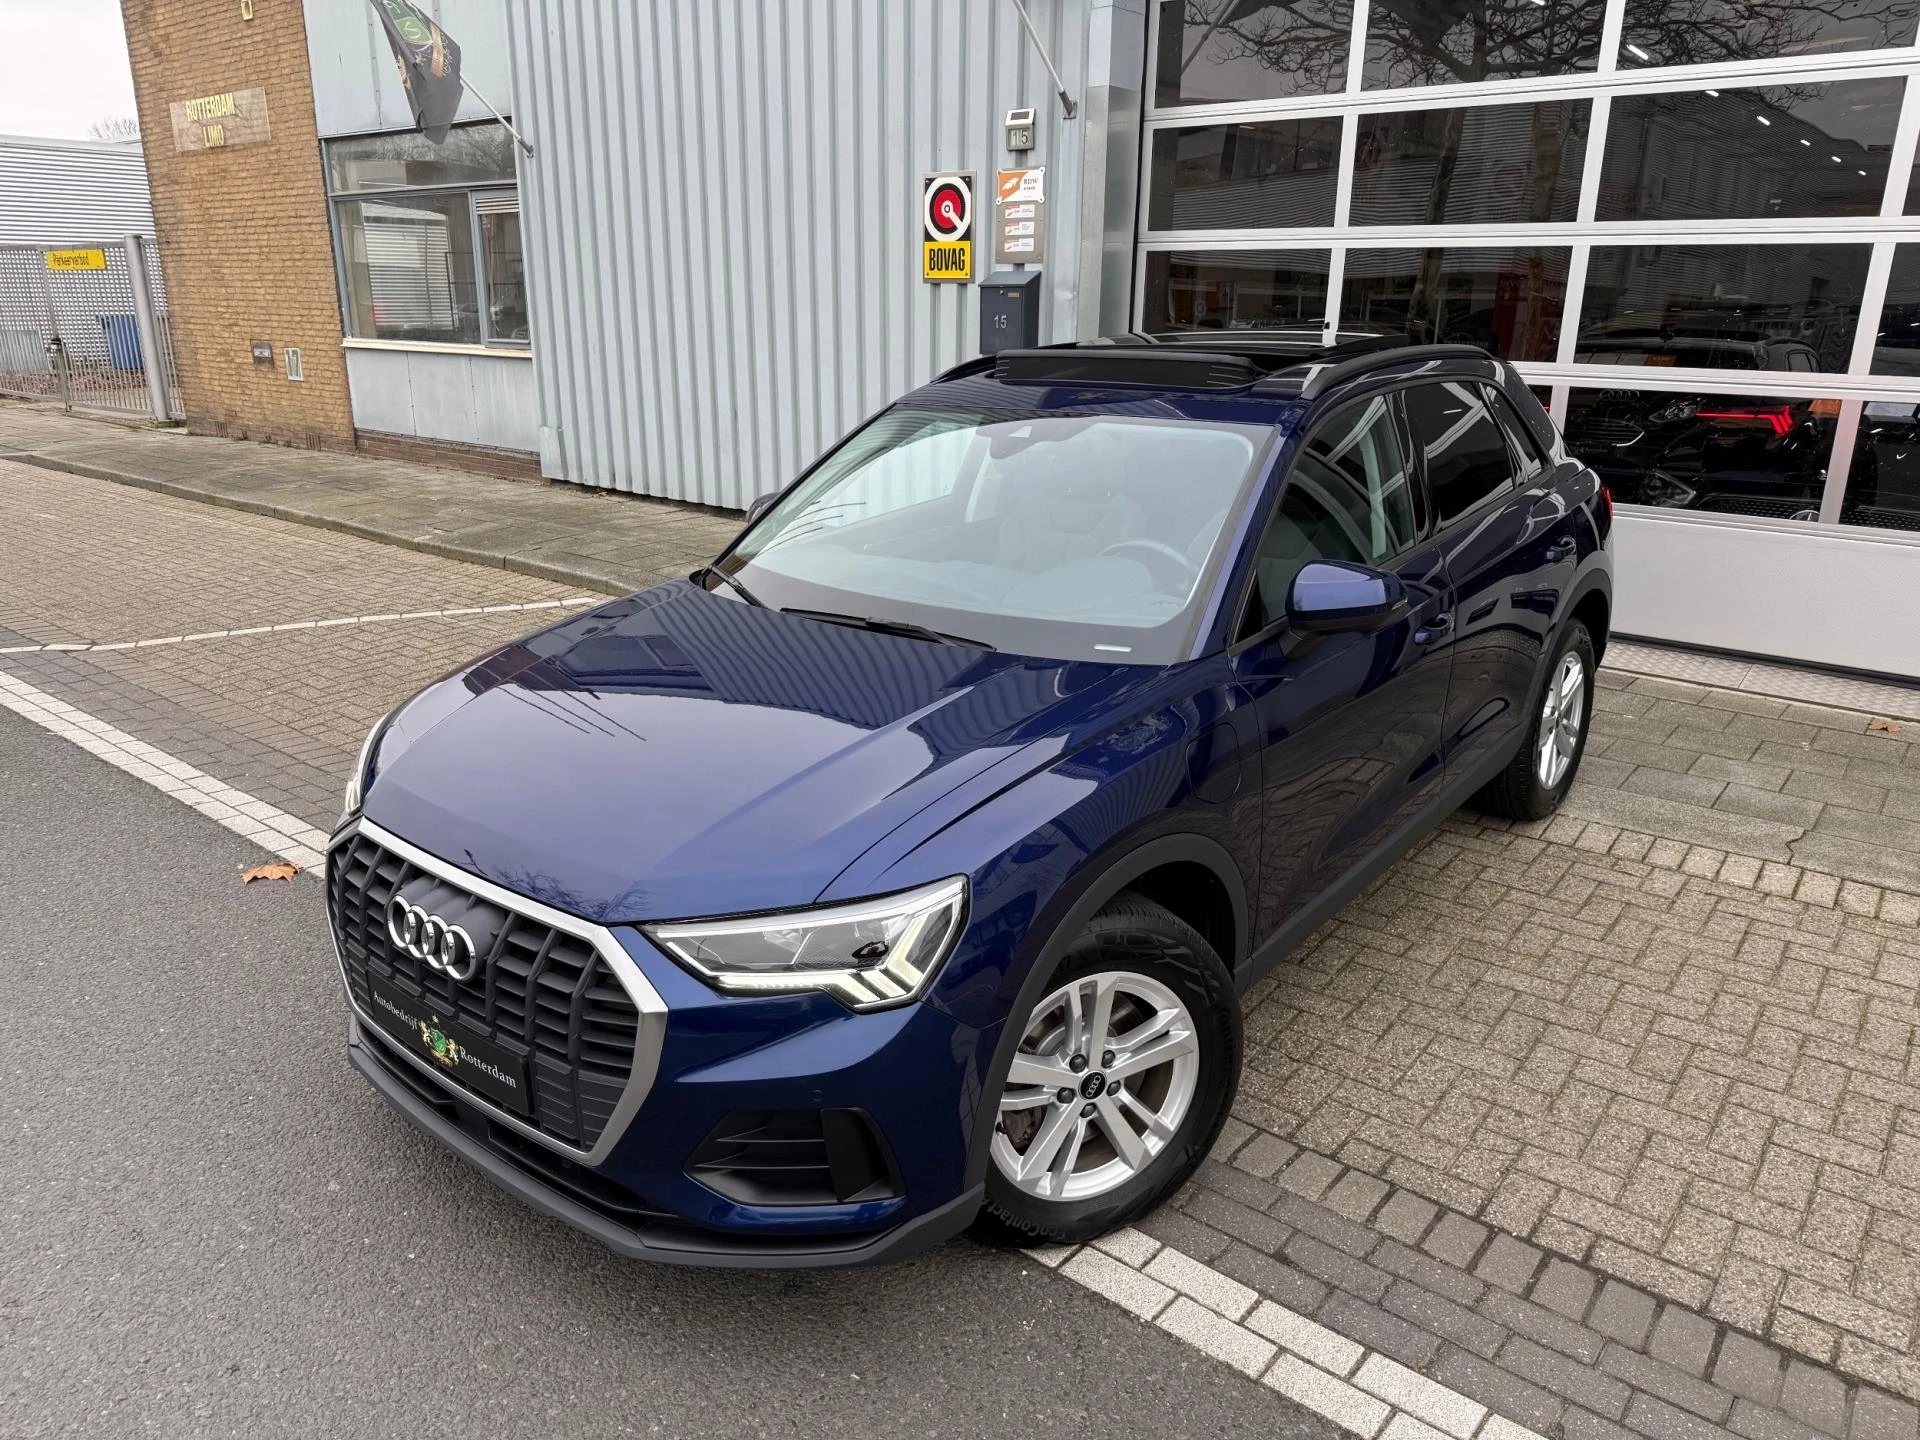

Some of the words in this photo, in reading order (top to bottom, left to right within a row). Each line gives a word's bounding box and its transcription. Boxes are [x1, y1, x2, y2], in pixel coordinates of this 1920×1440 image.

[185, 92, 235, 122] ROTTERDAM
[203, 124, 225, 147] LIMO
[1012, 130, 1029, 145] 15
[929, 248, 966, 271] BOVAG
[994, 315, 1007, 329] 15
[374, 990, 419, 1030] Autobedrijf
[459, 1045, 517, 1088] Rotterdam
